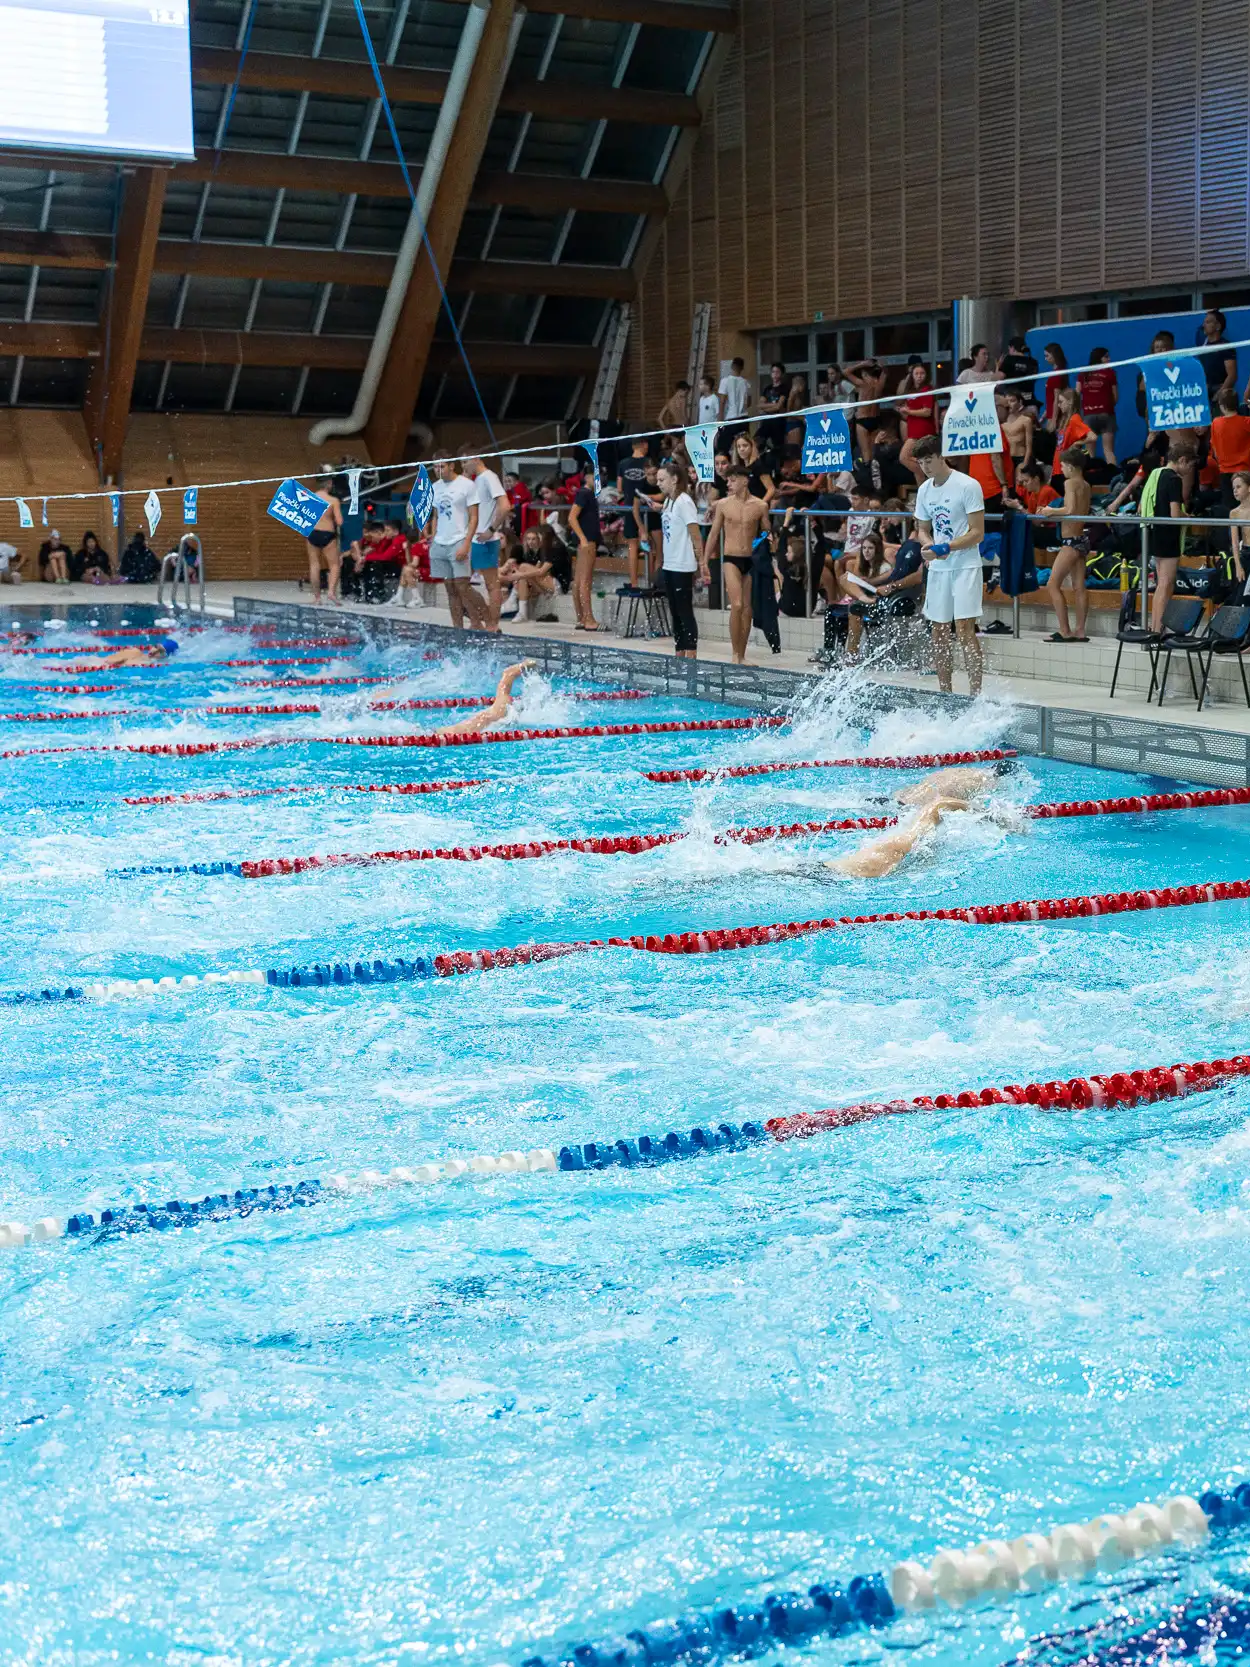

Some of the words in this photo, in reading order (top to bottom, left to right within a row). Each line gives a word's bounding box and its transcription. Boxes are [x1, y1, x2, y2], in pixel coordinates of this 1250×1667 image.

[1182, 382, 1202, 397] klub
[948, 415, 977, 428] Plivački
[978, 412, 995, 426] klub
[1152, 401, 1204, 427] Zadar
[807, 434, 830, 446] Plivački
[831, 432, 846, 444] klub
[947, 431, 997, 451] Zadar
[805, 448, 846, 467] Zadar
[271, 500, 313, 529] Zadar
[301, 503, 317, 520] klub
